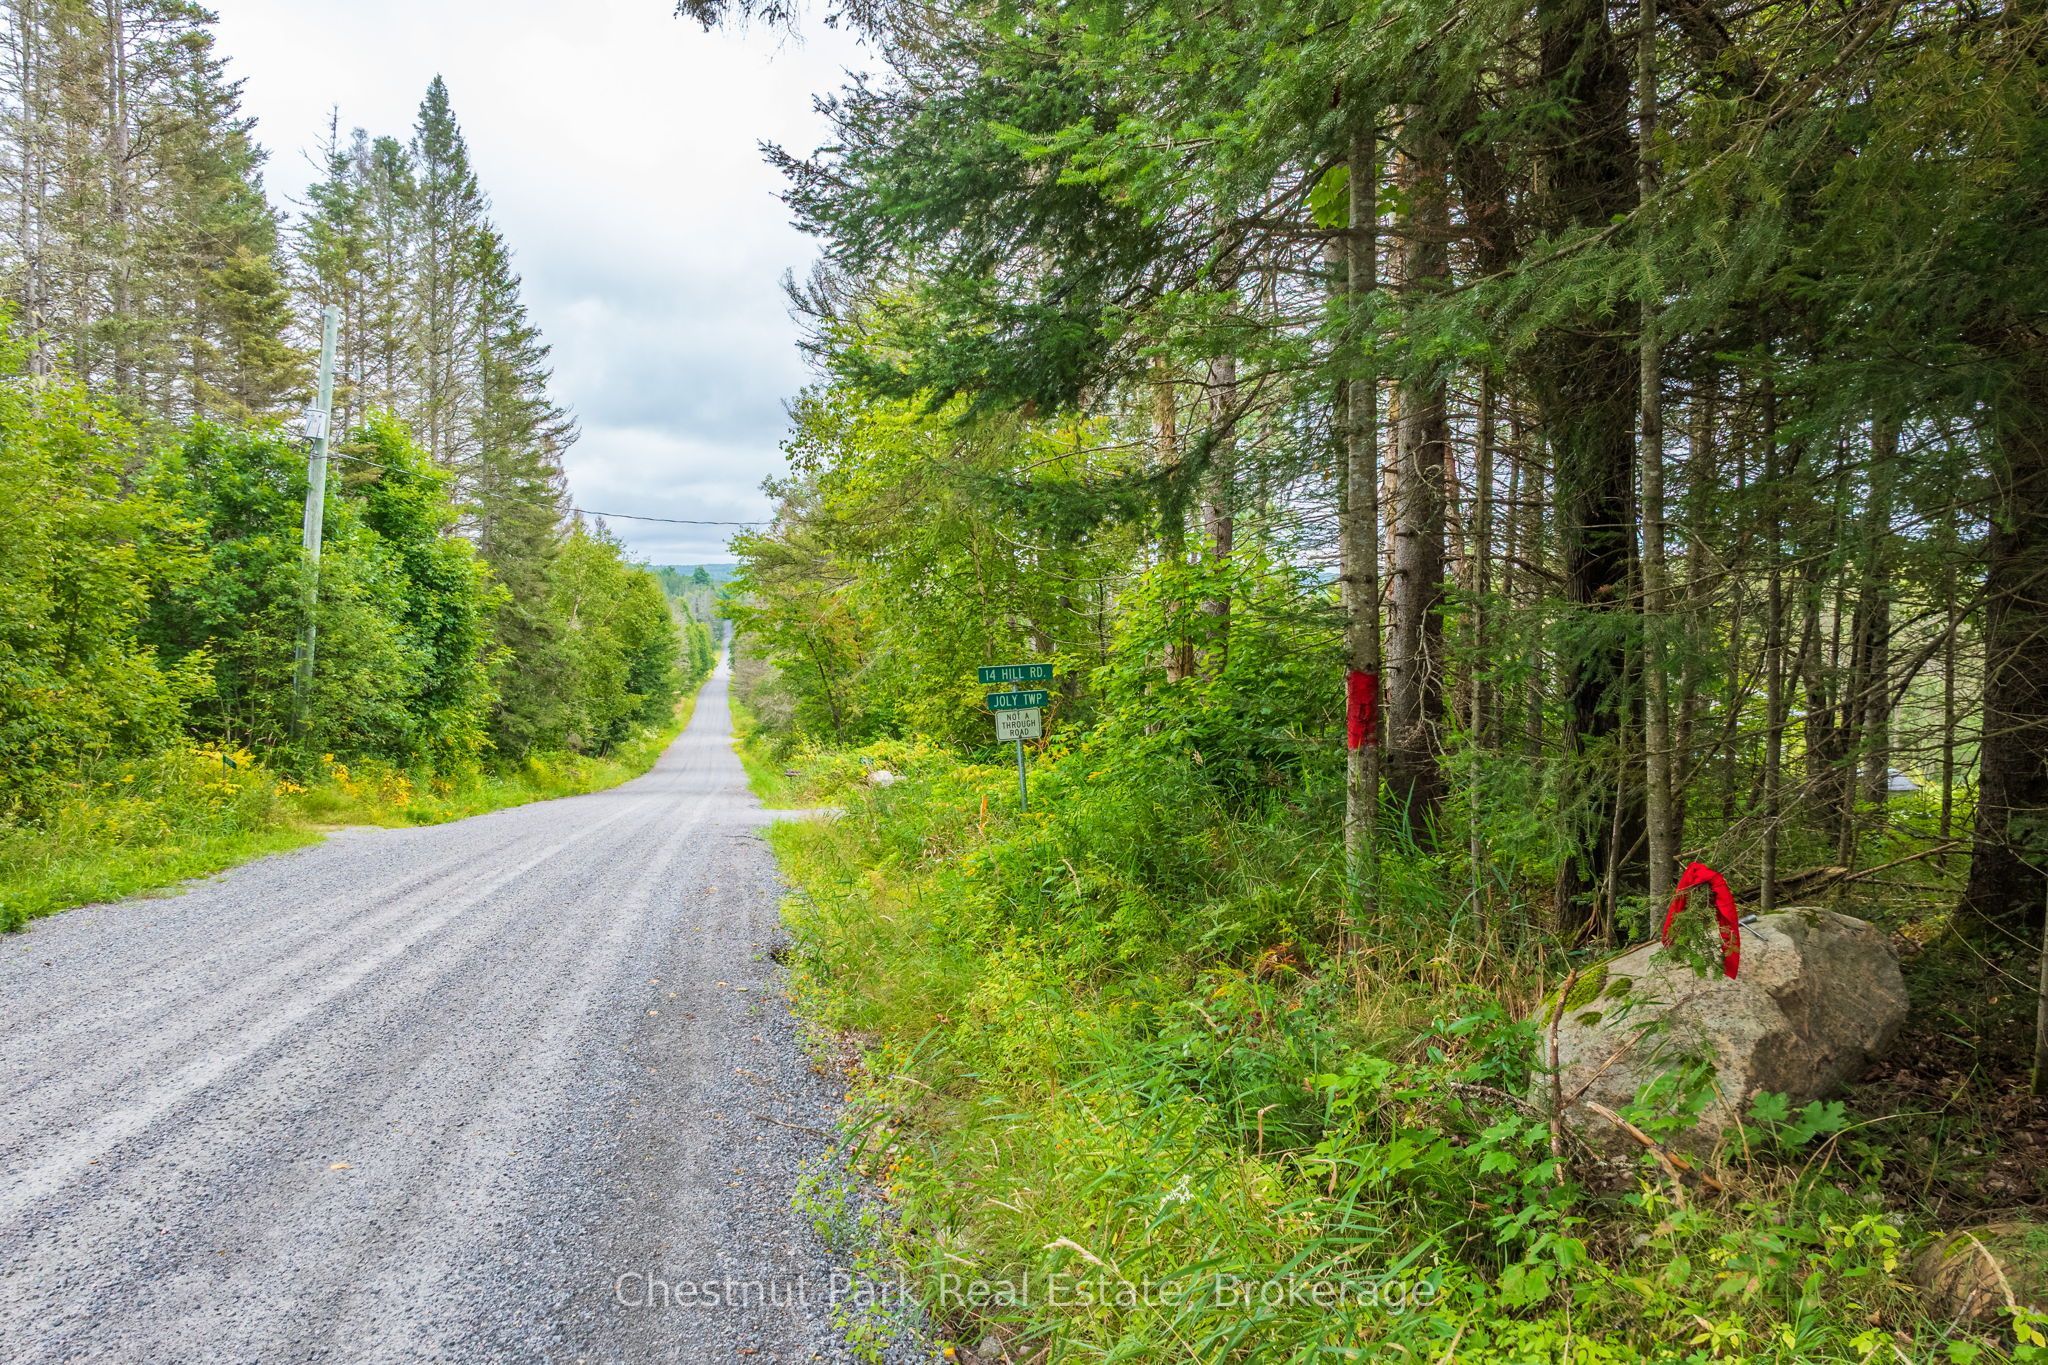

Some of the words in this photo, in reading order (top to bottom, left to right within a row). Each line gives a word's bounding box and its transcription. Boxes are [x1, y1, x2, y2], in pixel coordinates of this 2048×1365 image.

[985, 669, 996, 681] 14
[1001, 667, 1024, 680] HILL
[1030, 666, 1046, 678] RD.
[993, 694, 1018, 708] JOLY
[1023, 693, 1043, 705] TWP
[1006, 713, 1020, 721] NOT
[1025, 712, 1030, 720] A
[1002, 720, 1036, 730] THROUGH
[1010, 728, 1029, 736] ROAD
